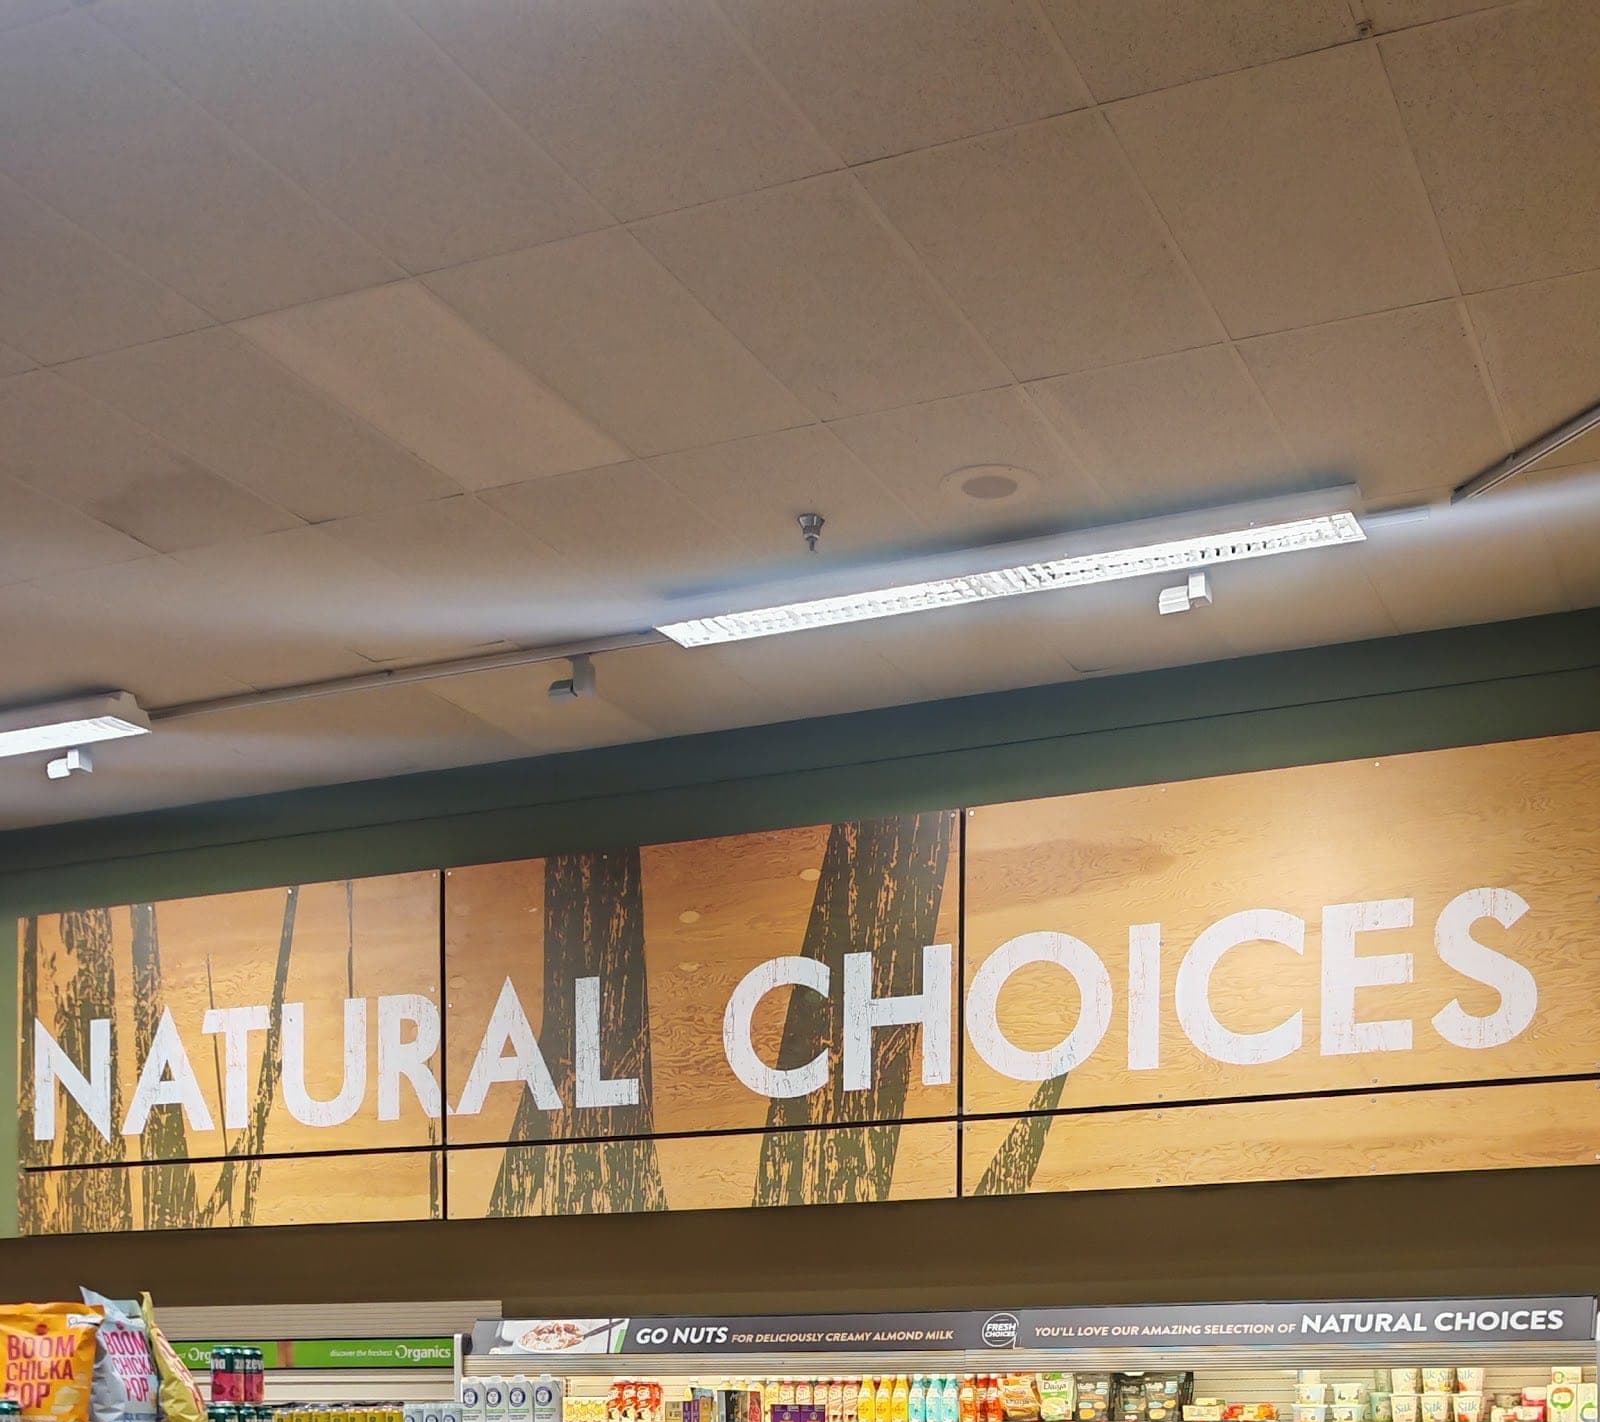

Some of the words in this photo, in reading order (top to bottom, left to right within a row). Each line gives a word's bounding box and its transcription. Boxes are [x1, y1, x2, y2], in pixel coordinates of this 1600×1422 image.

[34, 975, 639, 1142] NATURAL
[723, 886, 1538, 1099] CHOICES
[986, 1323, 1017, 1332] FRESH
[1034, 1326, 1075, 1337] YOU'LL
[1077, 1326, 1109, 1337] LOVE
[1111, 1325, 1140, 1336] OUR
[1142, 1325, 1202, 1336] AMAZING
[1203, 1323, 1274, 1335] SELECTION
[1277, 1323, 1297, 1334] OF
[1301, 1312, 1428, 1334] NATURAL
[1434, 1310, 1565, 1331] CHOICES
[102, 1330, 150, 1356] BOOM
[636, 1328, 668, 1344] GO
[672, 1326, 728, 1344] NUTS
[731, 1334, 753, 1343] FOR
[755, 1332, 824, 1343] DELICIOUSLY
[825, 1331, 872, 1342] CREAMY
[873, 1330, 924, 1341] ALMOND
[925, 1330, 954, 1341] MILK
[7, 1334, 76, 1361] BOOM
[395, 1344, 451, 1362] Organics
[6, 1358, 75, 1381] CHICKA
[112, 1355, 155, 1376] CHICKA
[4, 1381, 51, 1410] POP
[123, 1376, 150, 1402] POP
[1043, 1381, 1067, 1391] Daiya
[1423, 1400, 1443, 1414] Silk
[1458, 1399, 1478, 1412] Silk
